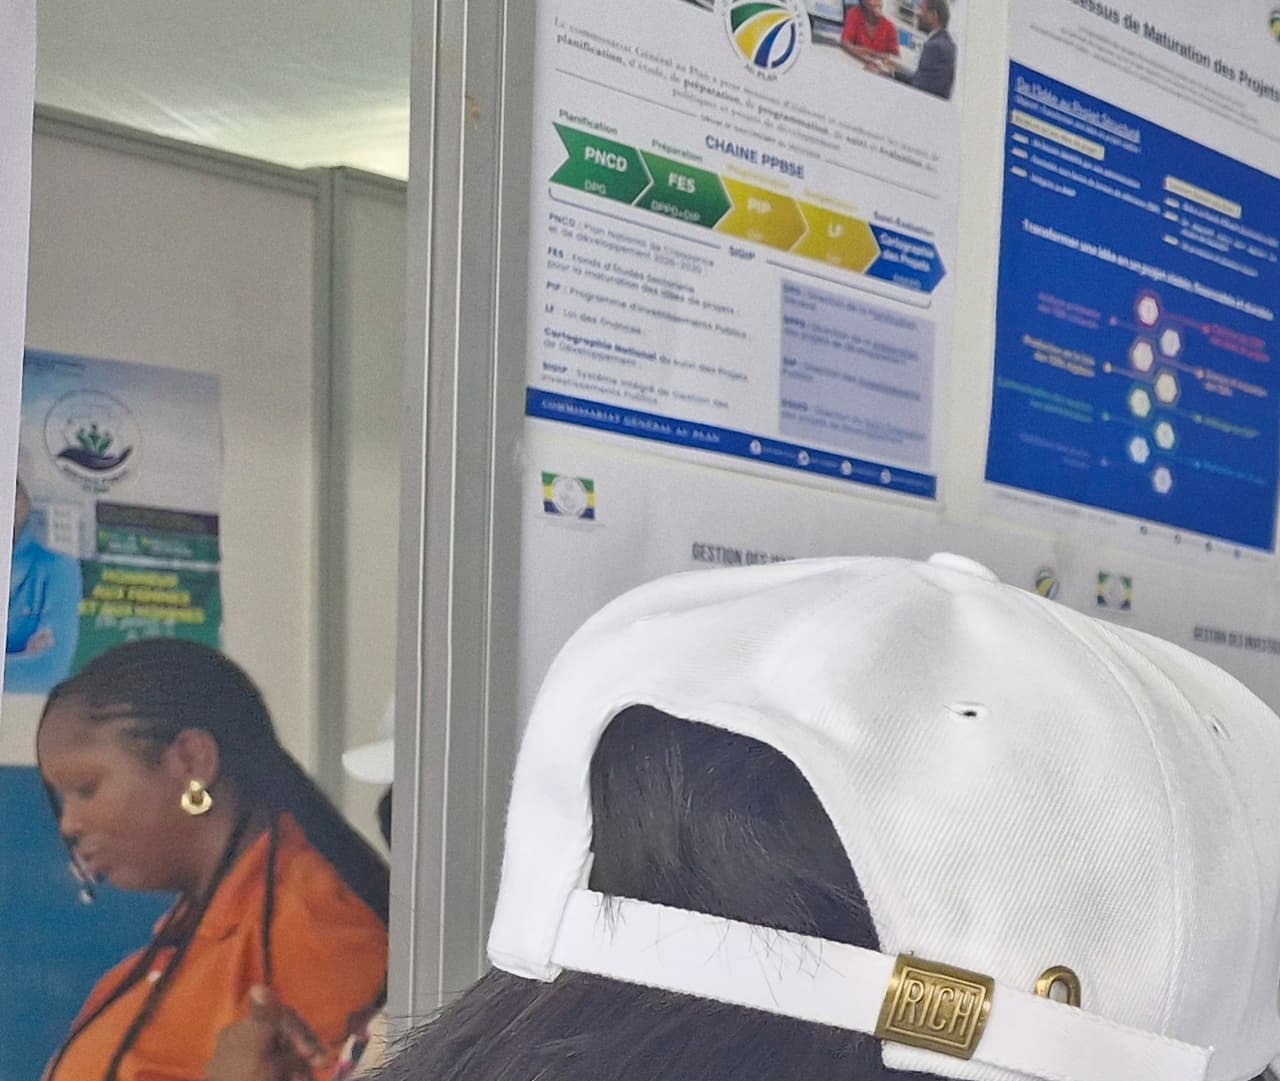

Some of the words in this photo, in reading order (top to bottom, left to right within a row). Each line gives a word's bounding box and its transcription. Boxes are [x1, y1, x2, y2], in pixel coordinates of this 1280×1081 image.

[1123, 14, 1141, 32] de
[1142, 21, 1210, 69] Maturation
[1213, 55, 1236, 81] des
[1239, 68, 1280, 103] Projets
[559, 109, 618, 135] Planification
[584, 146, 628, 173] PNCD
[705, 134, 757, 165] CHAINE
[761, 157, 805, 179] PPBSE
[584, 180, 607, 195] DPG
[668, 173, 696, 194] FES
[549, 213, 576, 227] PNCD
[1023, 218, 1079, 249] Transformer
[548, 247, 564, 259] FES
[544, 327, 612, 351] Cartographie
[692, 541, 742, 567] GESTION
[899, 979, 978, 1037] RICH
